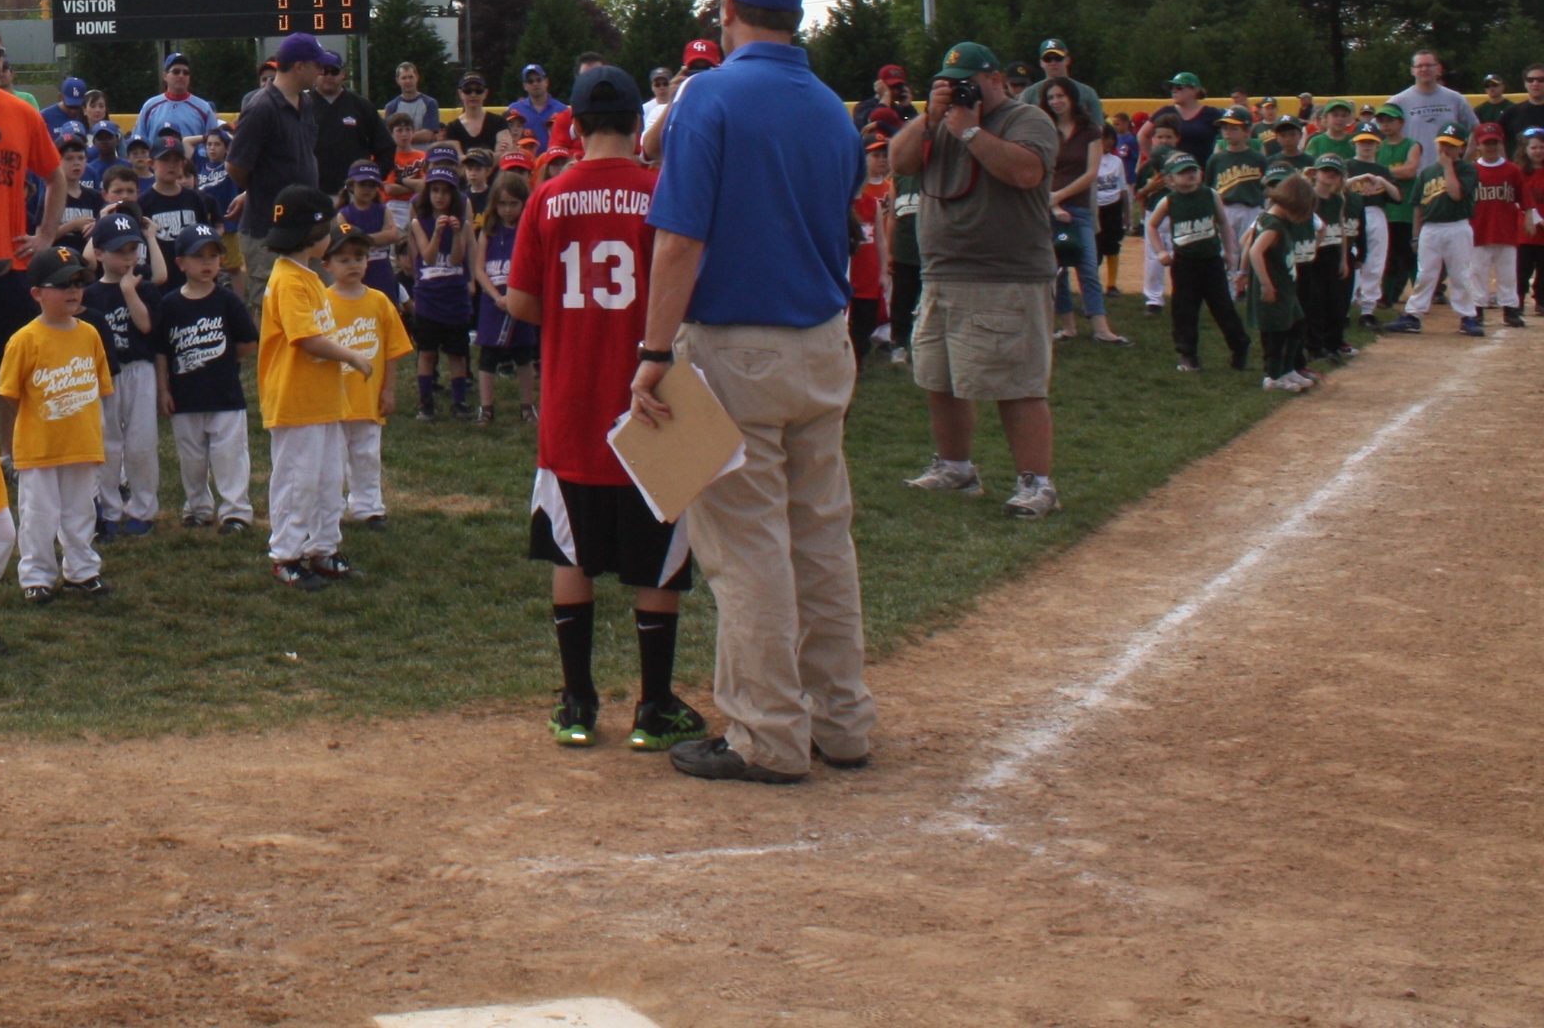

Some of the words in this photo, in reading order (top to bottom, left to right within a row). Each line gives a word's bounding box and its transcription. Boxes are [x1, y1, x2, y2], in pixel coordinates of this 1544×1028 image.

[62, 0, 116, 13] VISITOR
[76, 20, 116, 35] HOME
[547, 189, 611, 220] TUTORING
[614, 189, 650, 215] CLUB
[274, 205, 284, 222] P
[115, 218, 131, 230] NY
[196, 225, 212, 236] NY
[340, 224, 352, 234] P
[57, 248, 71, 262] P
[560, 240, 636, 309] 13
[196, 316, 224, 332] Hill
[175, 330, 225, 353] Atlantic
[32, 364, 74, 387] Cherry
[69, 356, 95, 374] Hill
[43, 374, 97, 397] Atlantic
